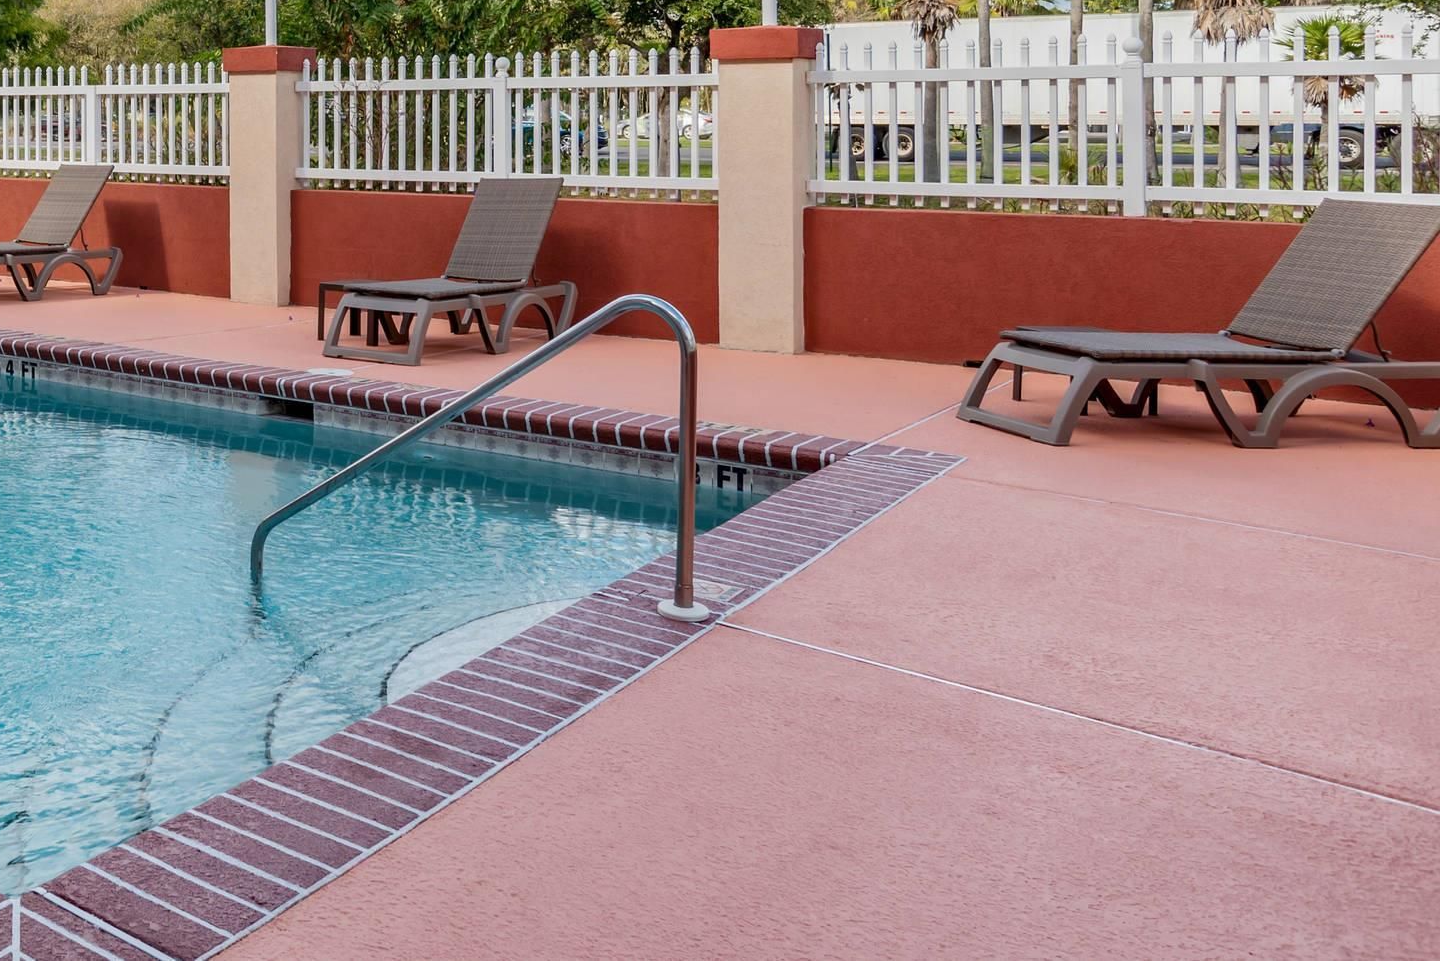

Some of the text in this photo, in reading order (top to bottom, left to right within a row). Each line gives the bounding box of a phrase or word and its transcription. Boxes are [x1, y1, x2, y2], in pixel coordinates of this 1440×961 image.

[5, 359, 38, 379] 4 FT
[717, 464, 747, 492] FT
